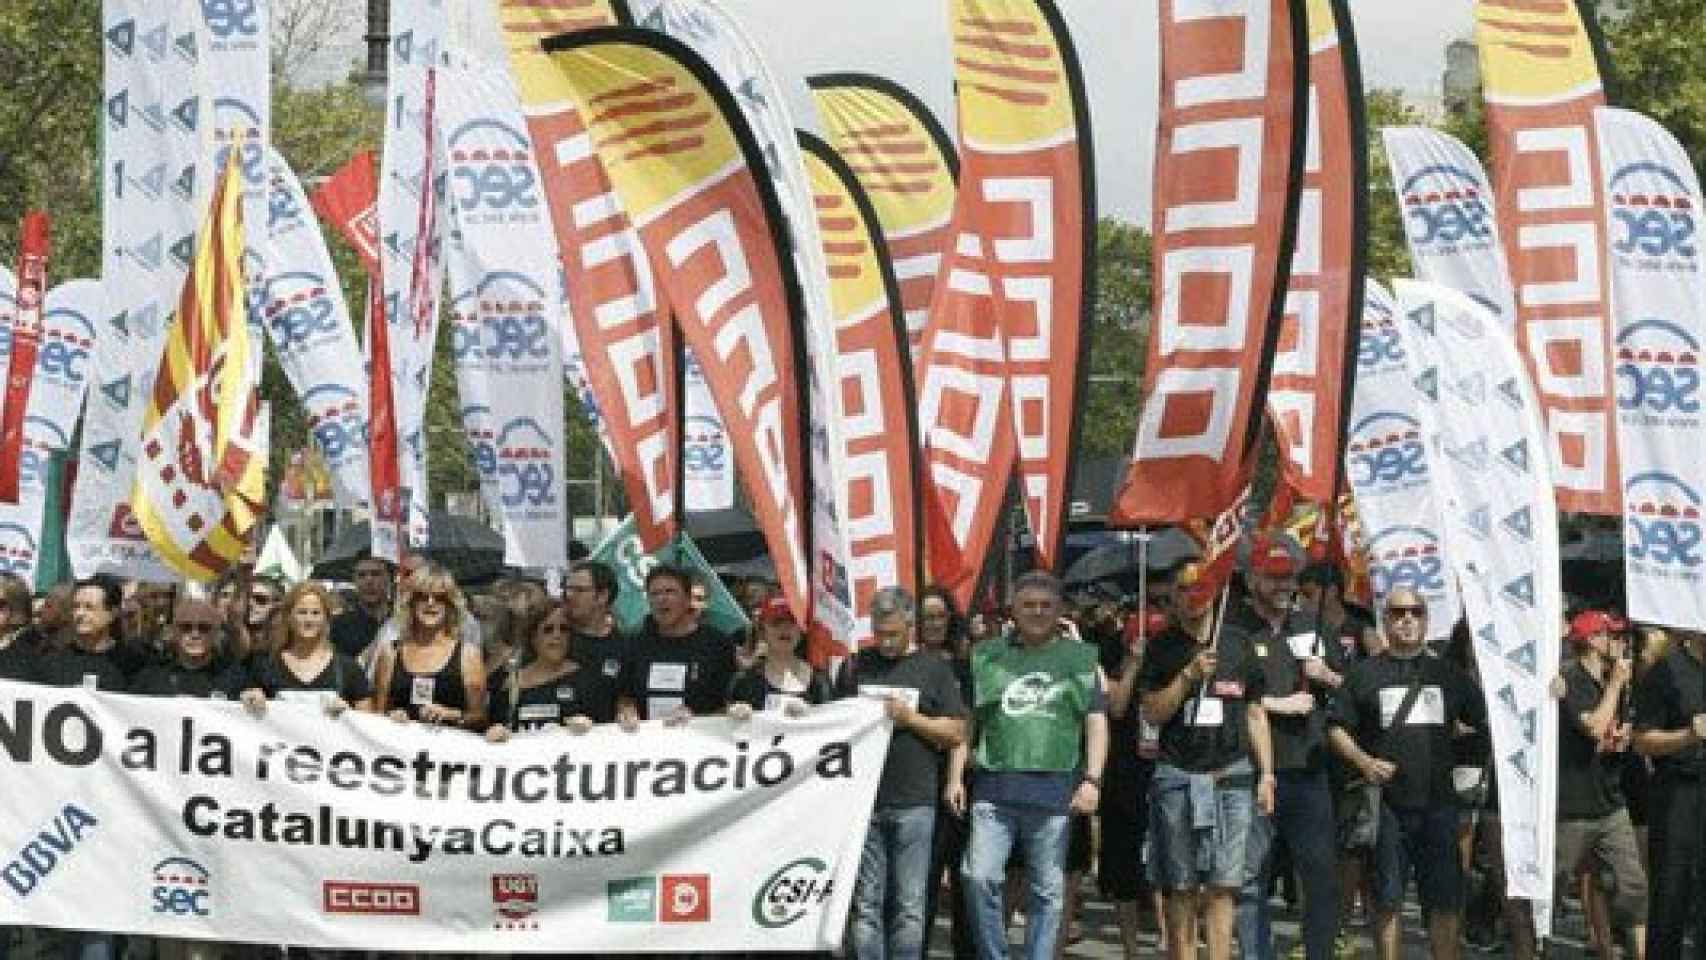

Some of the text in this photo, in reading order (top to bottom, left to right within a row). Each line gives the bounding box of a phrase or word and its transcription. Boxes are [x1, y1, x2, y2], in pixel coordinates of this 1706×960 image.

[40, 341, 90, 381] ec
[0, 699, 853, 804] NO a la reestructuració a
[1, 801, 98, 897] BBVA
[181, 794, 627, 864] CatalunyaCaixa
[151, 885, 210, 916] sec
